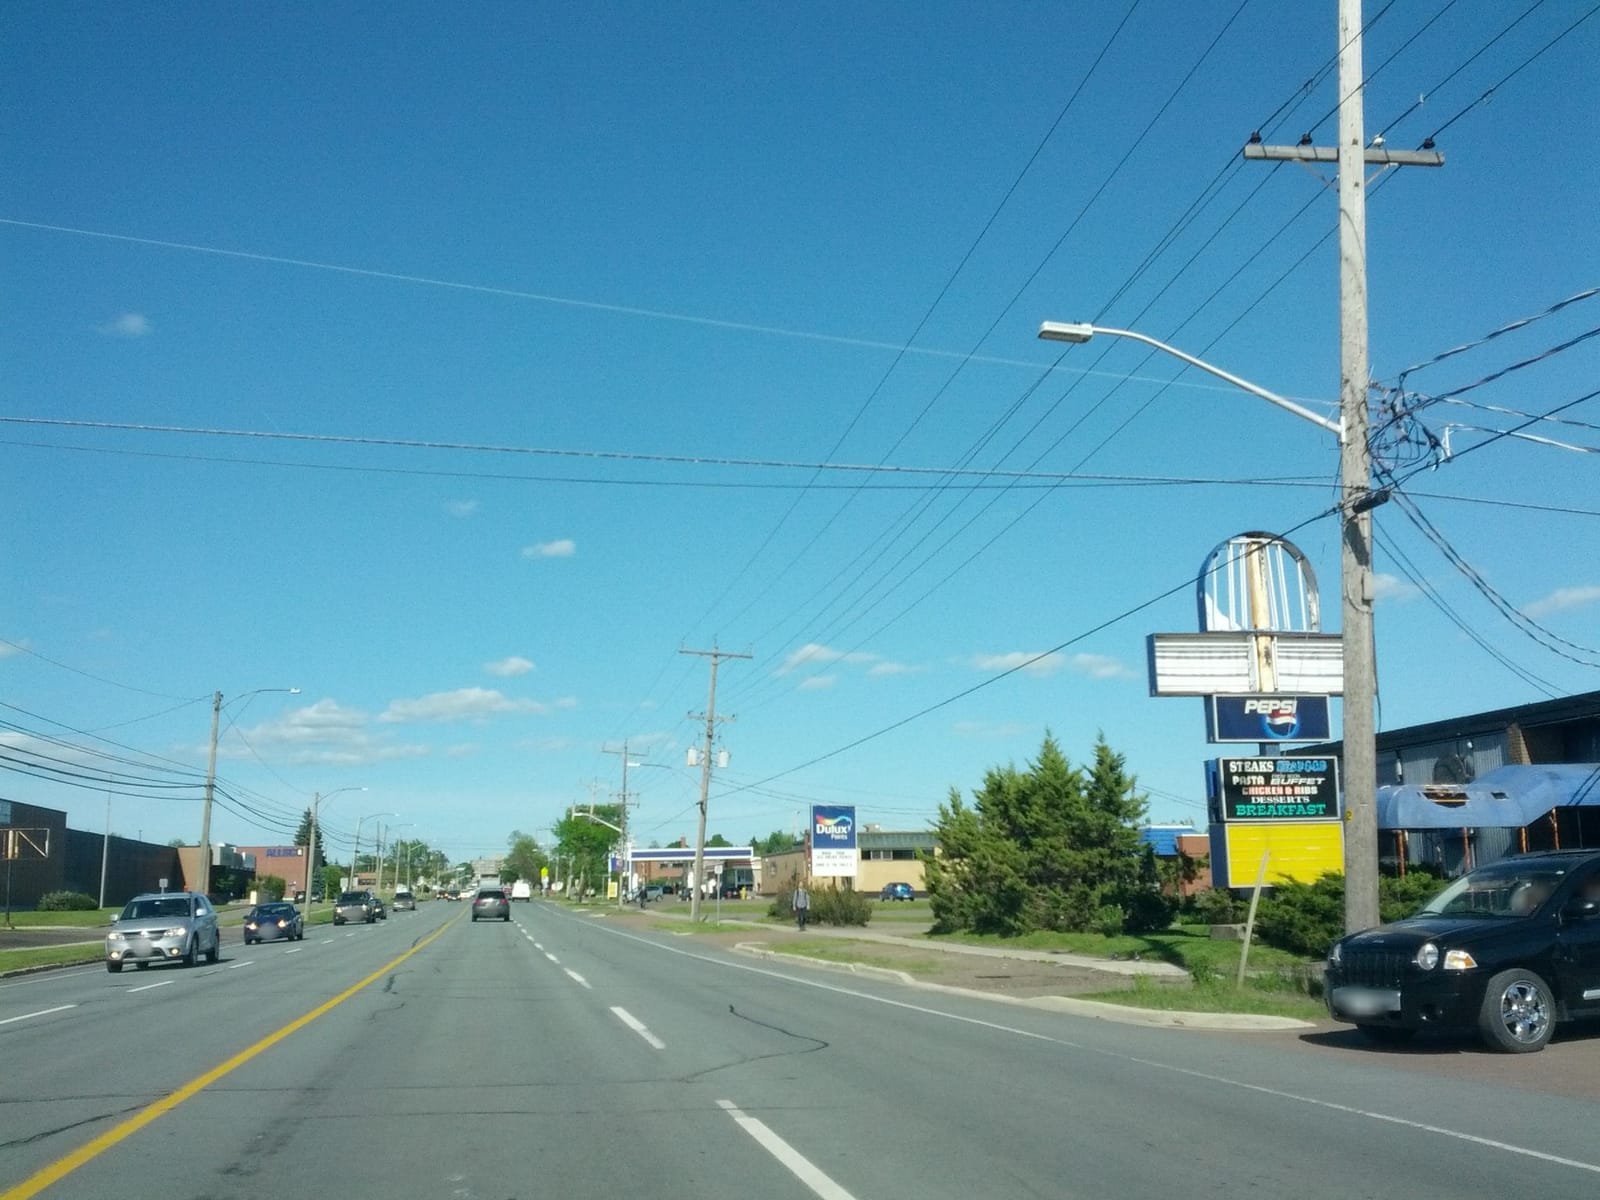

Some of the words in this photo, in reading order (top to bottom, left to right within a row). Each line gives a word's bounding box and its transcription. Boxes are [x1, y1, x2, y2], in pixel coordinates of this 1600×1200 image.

[1244, 699, 1298, 715] PEPSI
[1229, 760, 1274, 772] STEAKS
[1232, 775, 1265, 786] PASTA
[1270, 777, 1326, 785] BUFFET
[1242, 786, 1284, 796] CHICKEN
[1294, 786, 1318, 796] RIBS
[1251, 796, 1310, 804] DESSERTS
[1235, 804, 1326, 816] BREAKFAST
[816, 824, 848, 834] Dulux
